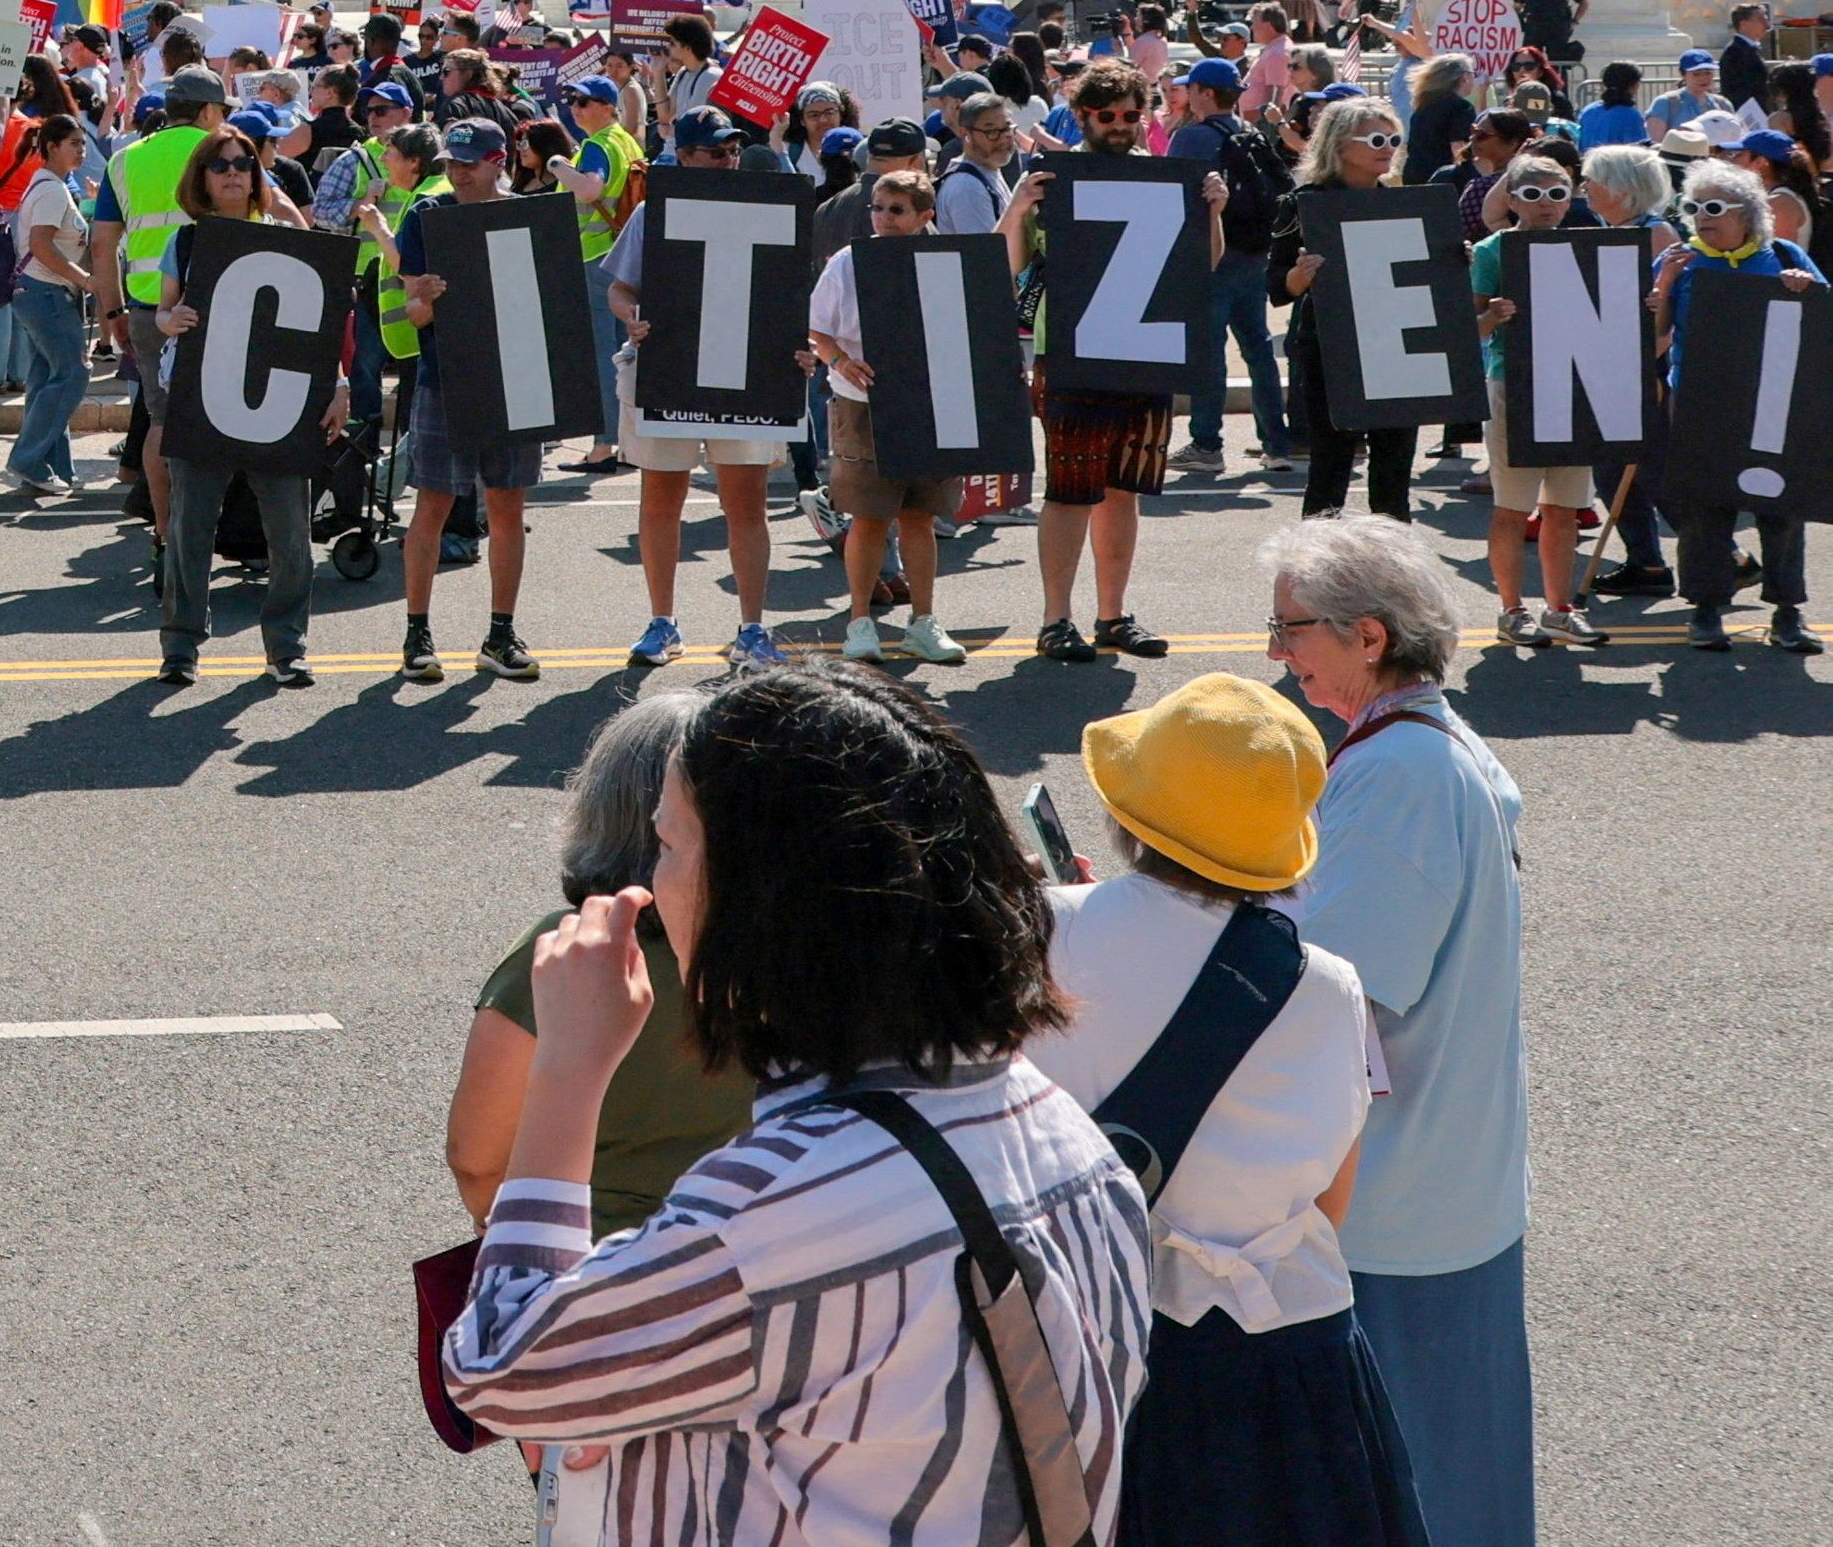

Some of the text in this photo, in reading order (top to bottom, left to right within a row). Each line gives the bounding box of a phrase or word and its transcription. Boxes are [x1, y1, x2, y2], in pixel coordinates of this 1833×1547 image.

[1, 44, 11, 54] in
[745, 28, 812, 76] BIRTH
[769, 23, 807, 48] Protect
[822, 12, 904, 57] ICE
[1436, 25, 1517, 51] RACISM
[728, 73, 784, 107] Citizenship
[733, 50, 801, 96] RIGHT
[827, 62, 908, 101] OUT
[735, 98, 758, 114] ACLU
[664, 198, 796, 390] T
[1072, 180, 1187, 364] Z
[485, 227, 555, 430] I
[1340, 217, 1453, 400] E
[201, 250, 324, 444] C
[913, 252, 979, 449] I
[1528, 242, 1642, 443] N
